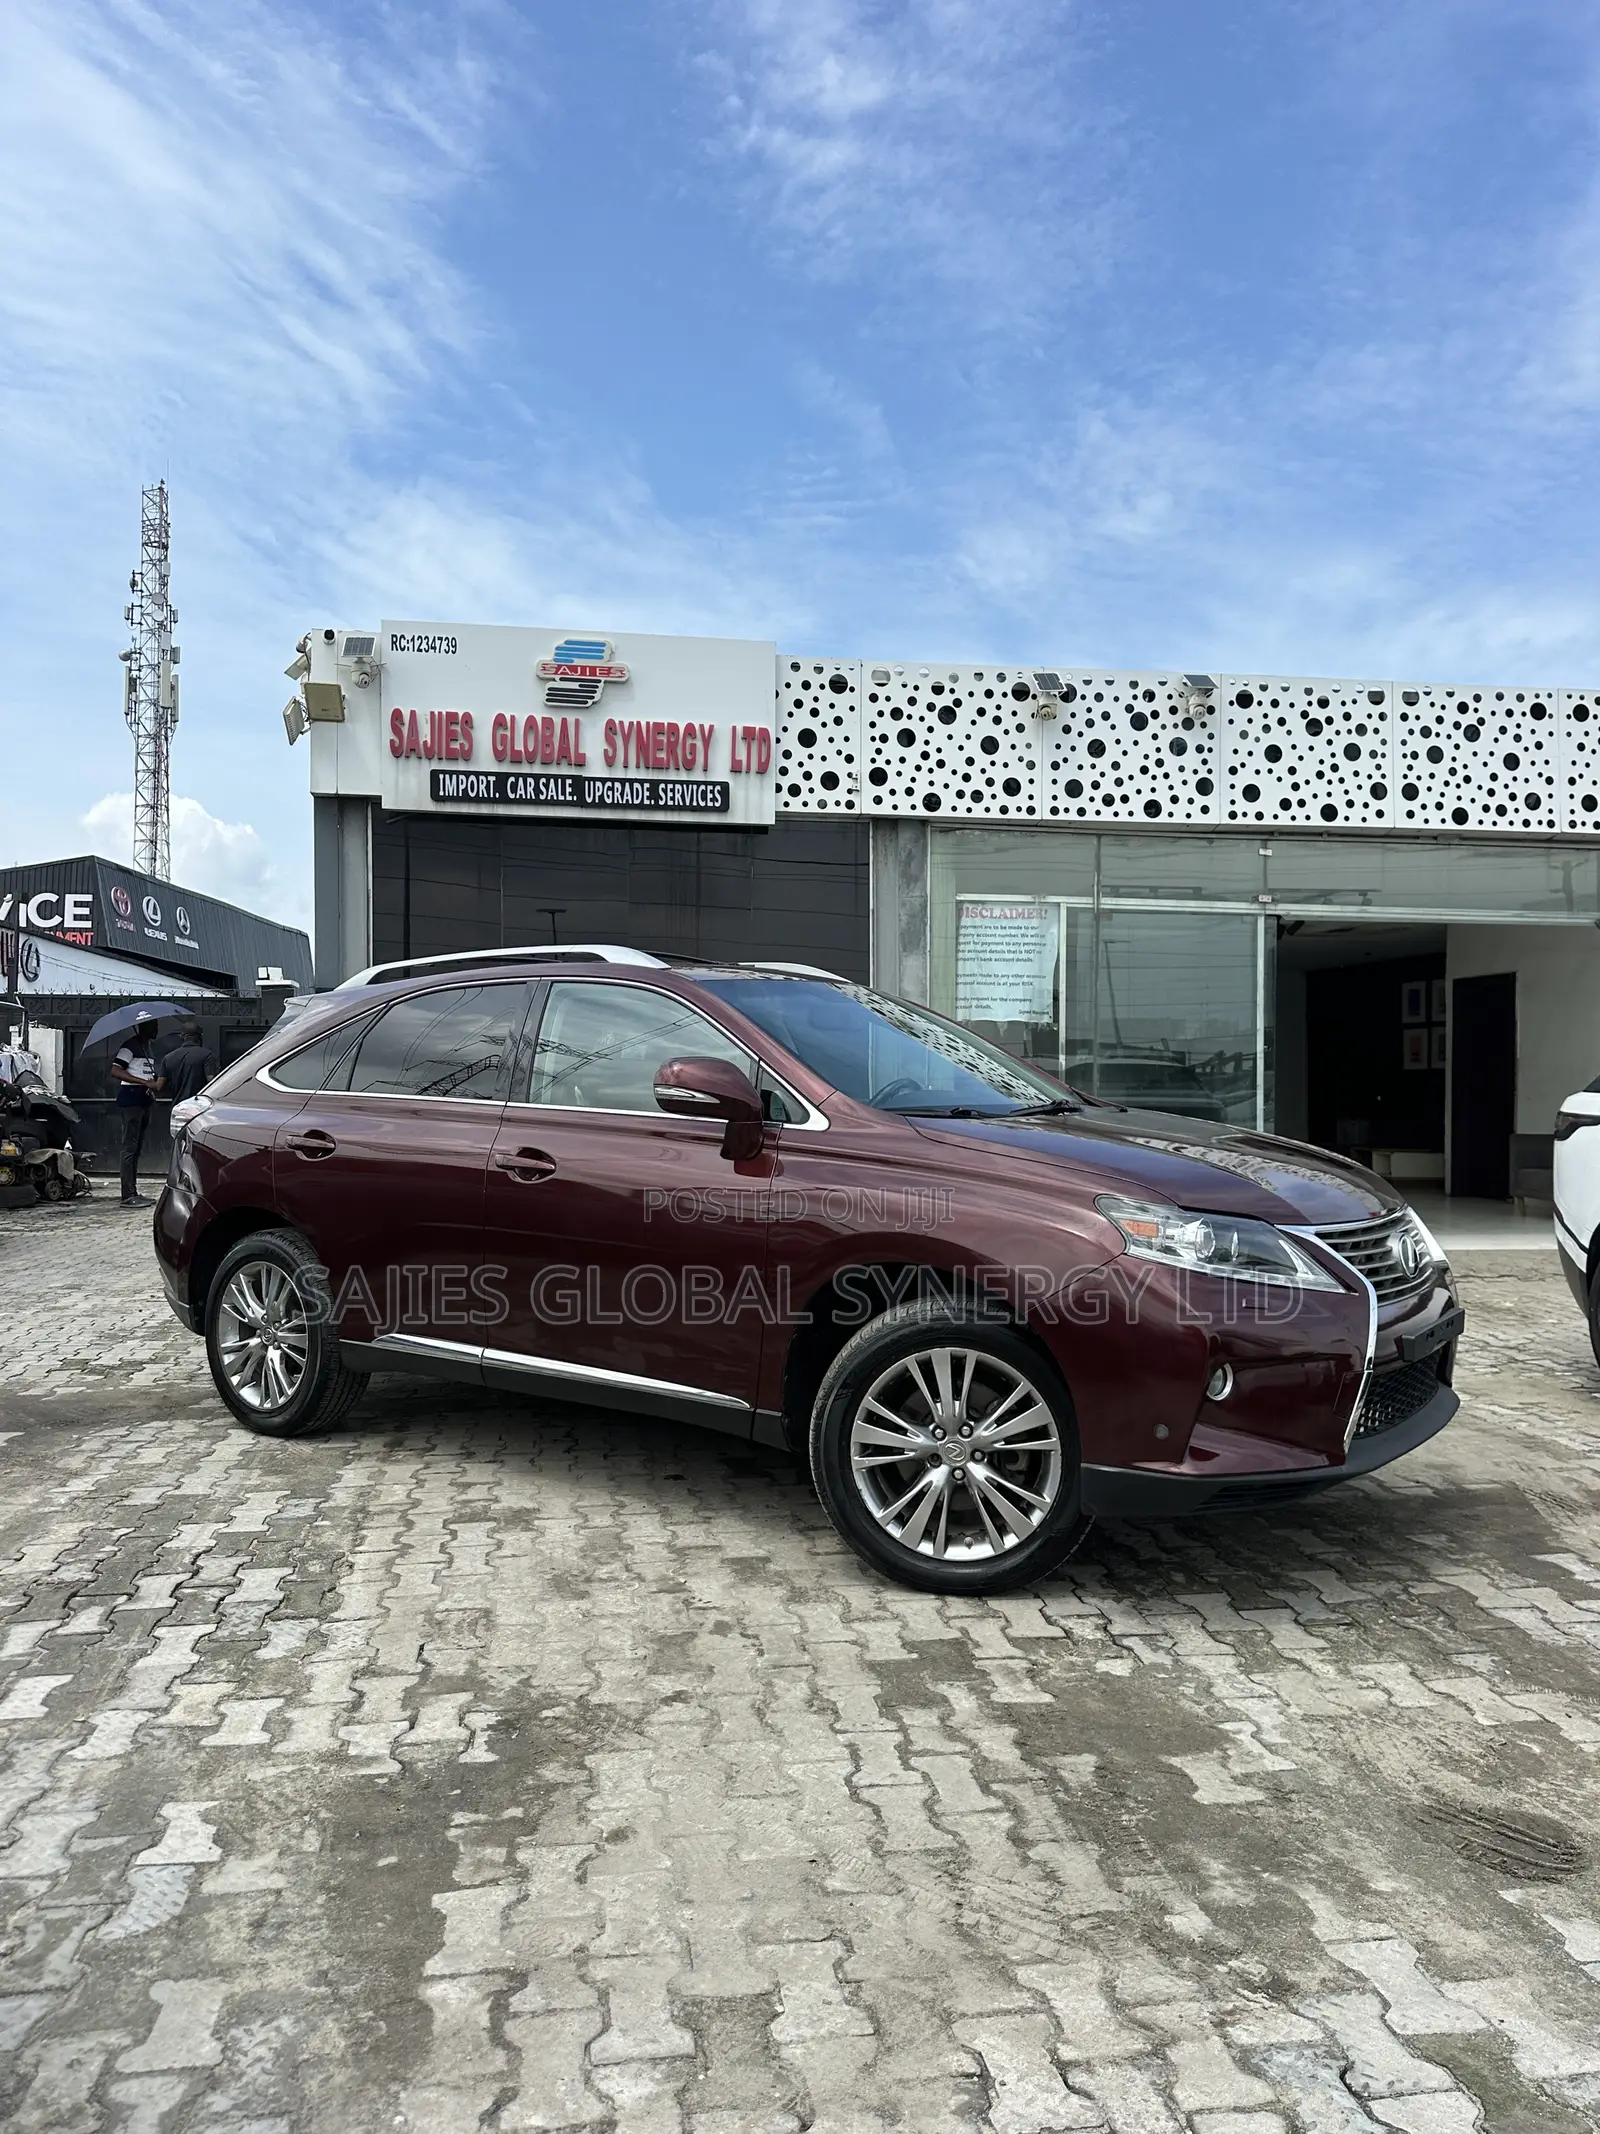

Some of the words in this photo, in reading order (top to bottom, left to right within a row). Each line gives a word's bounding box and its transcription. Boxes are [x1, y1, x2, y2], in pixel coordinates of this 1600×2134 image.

[390, 633, 458, 655] RC:1234739
[541, 663, 627, 678] SAJIES
[389, 707, 473, 761] SAJIES
[492, 712, 586, 766] GLOBAL
[603, 718, 714, 771] SYNERGY
[729, 724, 771, 774] LTD
[438, 773, 500, 799] IMPORT.
[507, 777, 536, 799] CAR
[539, 779, 577, 801] SALE.
[584, 780, 655, 805] UPGRADE.
[658, 783, 722, 807] SERVICES
